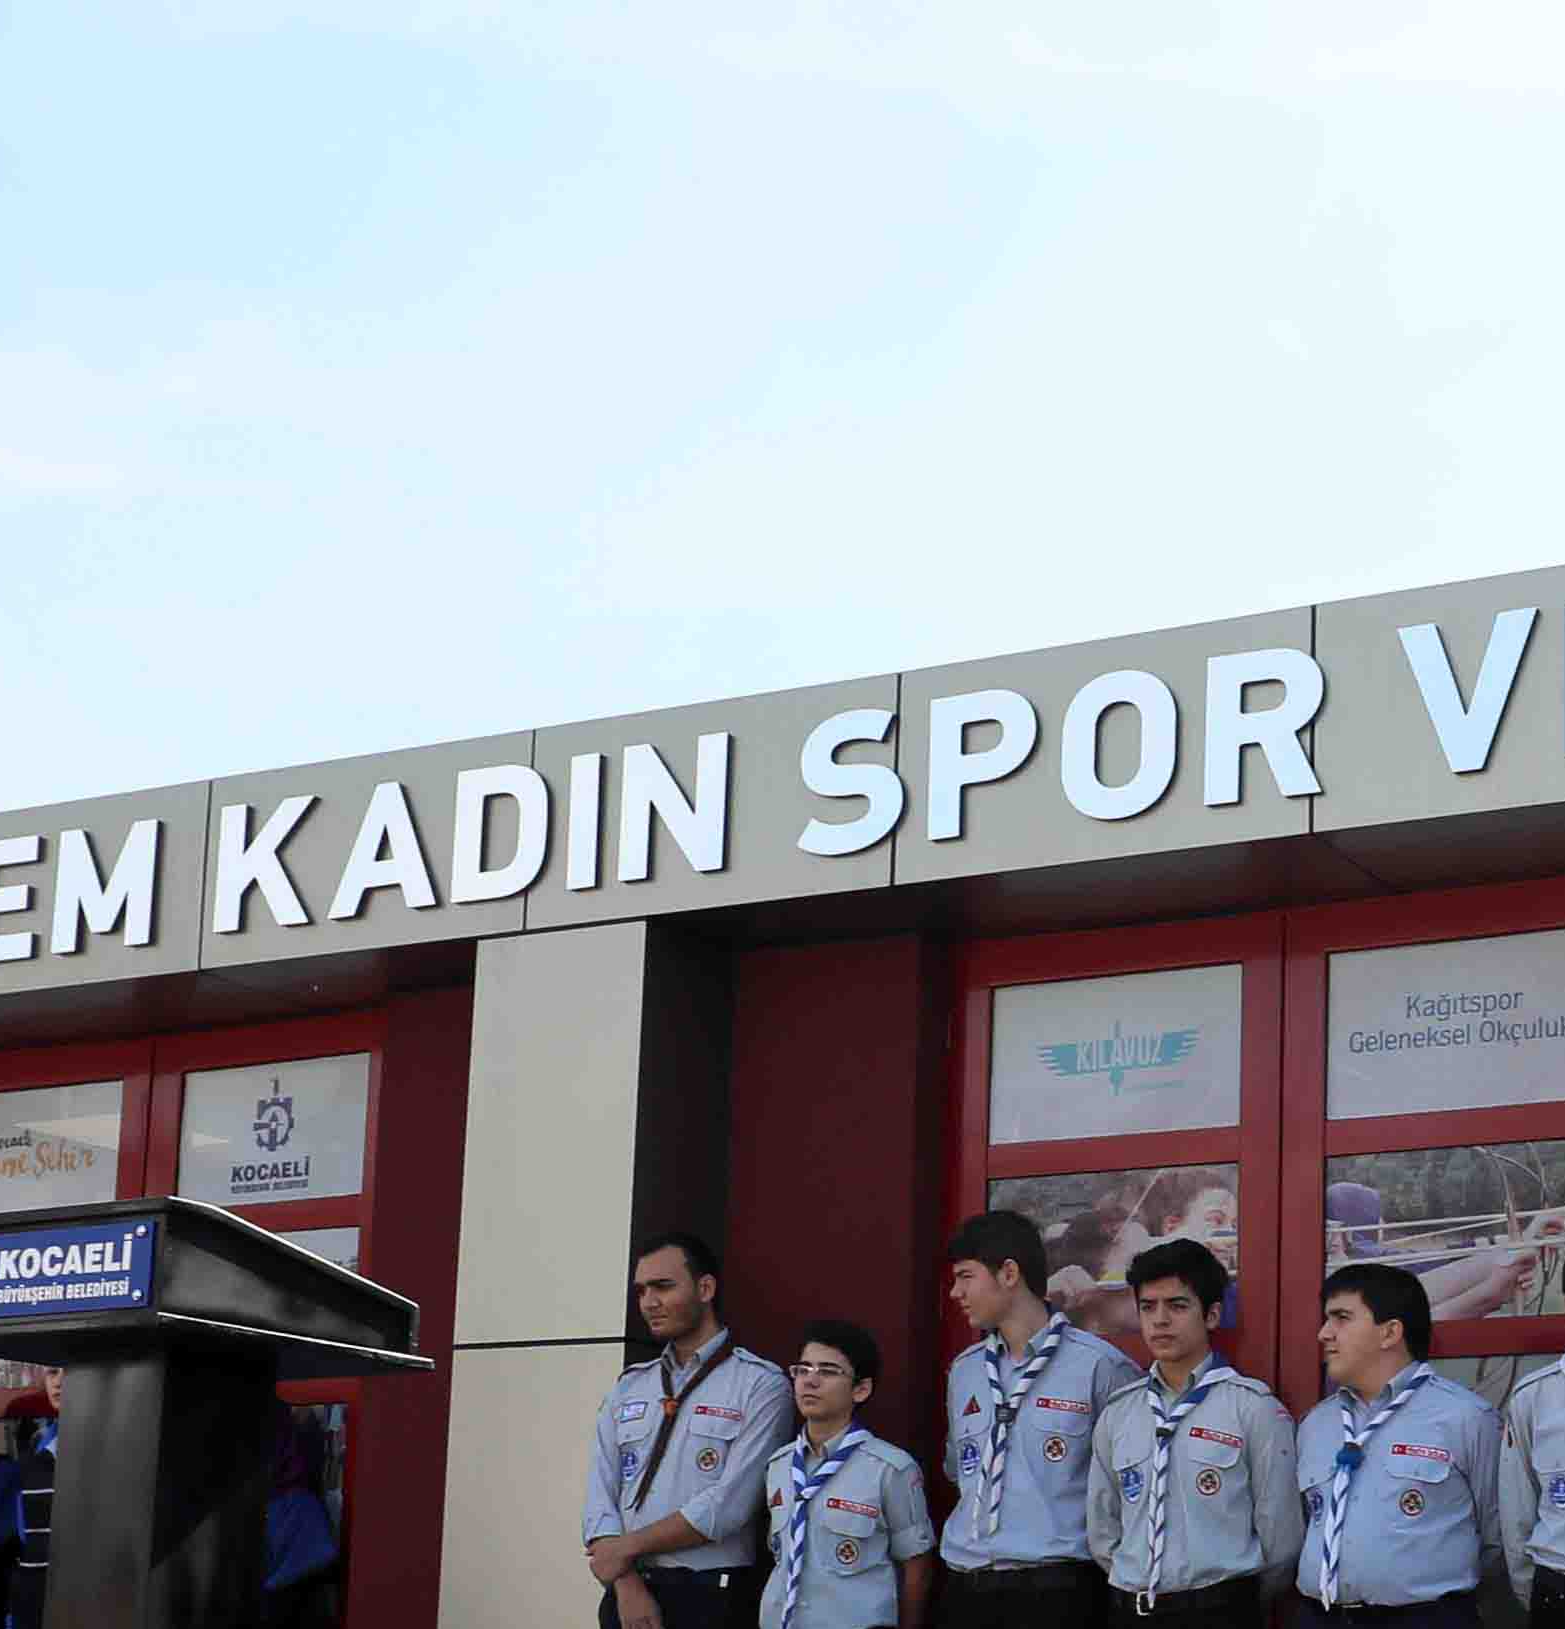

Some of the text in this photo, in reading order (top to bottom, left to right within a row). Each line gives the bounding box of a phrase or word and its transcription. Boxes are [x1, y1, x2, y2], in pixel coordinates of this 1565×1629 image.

[212, 730, 733, 935] KADIN
[796, 646, 1326, 857] SPOR
[1404, 991, 1524, 1022] Kağıtspor
[1348, 1023, 1472, 1054] Geleneksel
[231, 1155, 311, 1183] KOCAELİ
[66, 1275, 130, 1300] BELEDİYESİ
